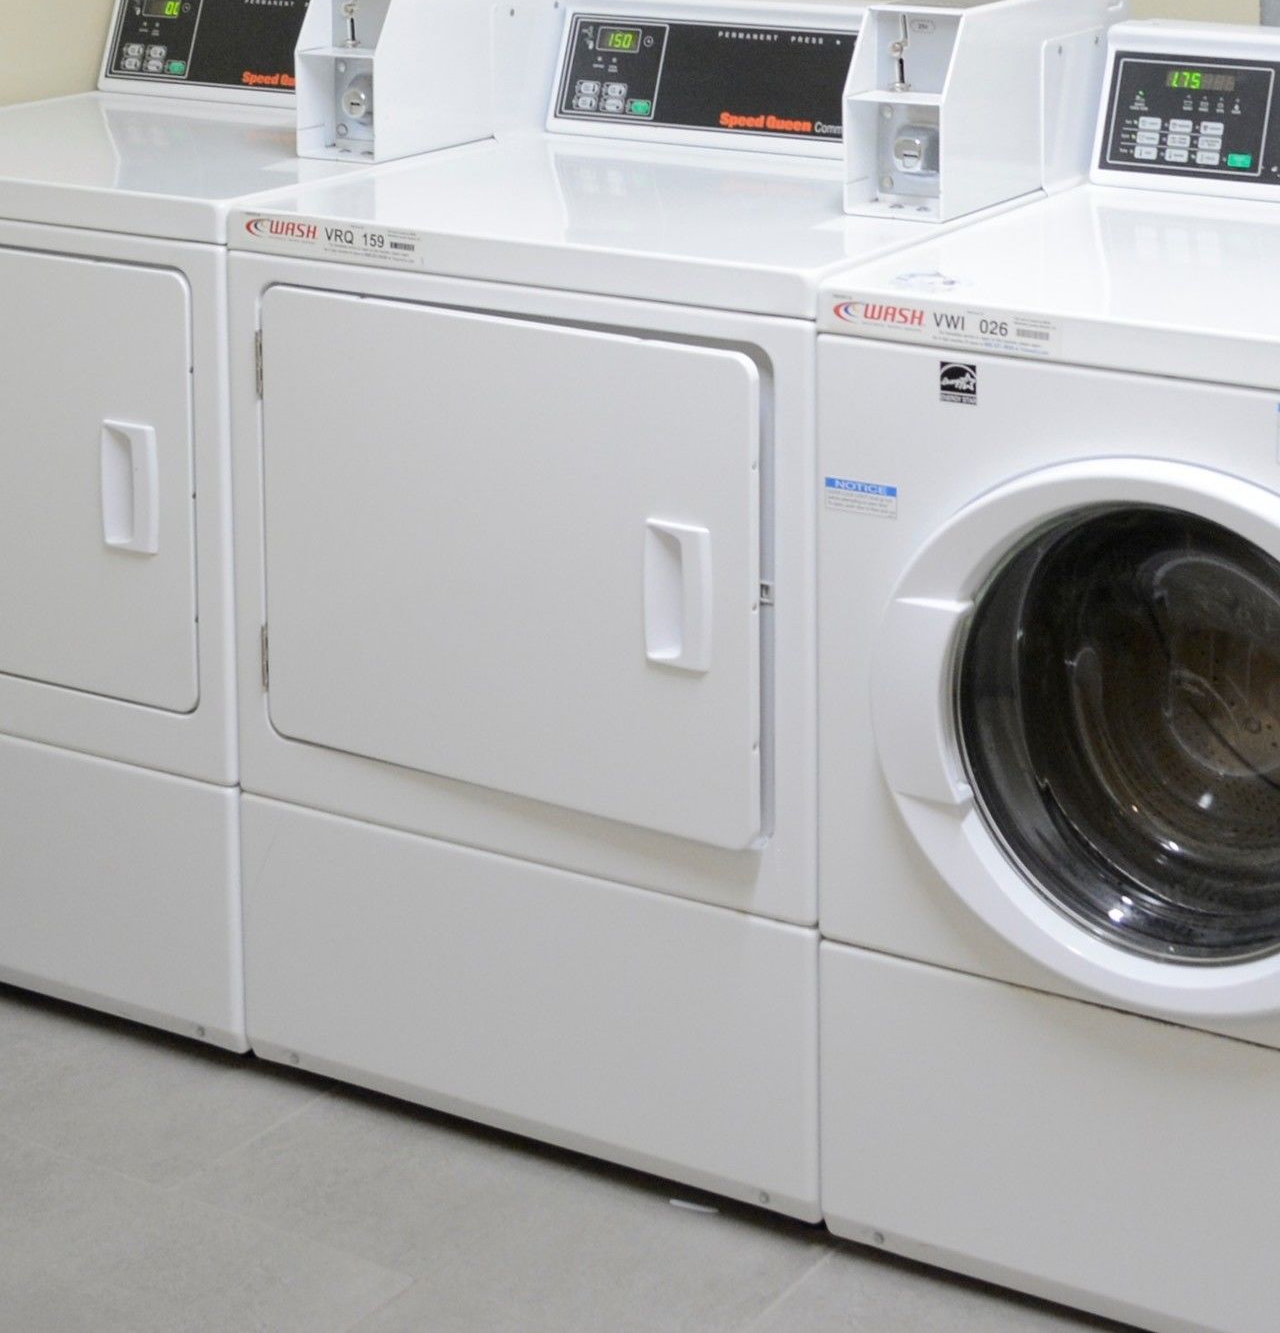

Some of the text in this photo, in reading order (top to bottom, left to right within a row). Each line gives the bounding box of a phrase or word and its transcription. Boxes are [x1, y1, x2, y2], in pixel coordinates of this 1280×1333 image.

[607, 32, 634, 49] 150
[718, 30, 824, 45] PERMANENT PRESS
[242, 70, 280, 86] Speed
[720, 112, 764, 132] Speed
[766, 115, 812, 133] Queen
[270, 221, 385, 249] WASH VRQ 159
[864, 303, 1009, 337] WASH VWI 026
[834, 479, 887, 494] NOTICE
